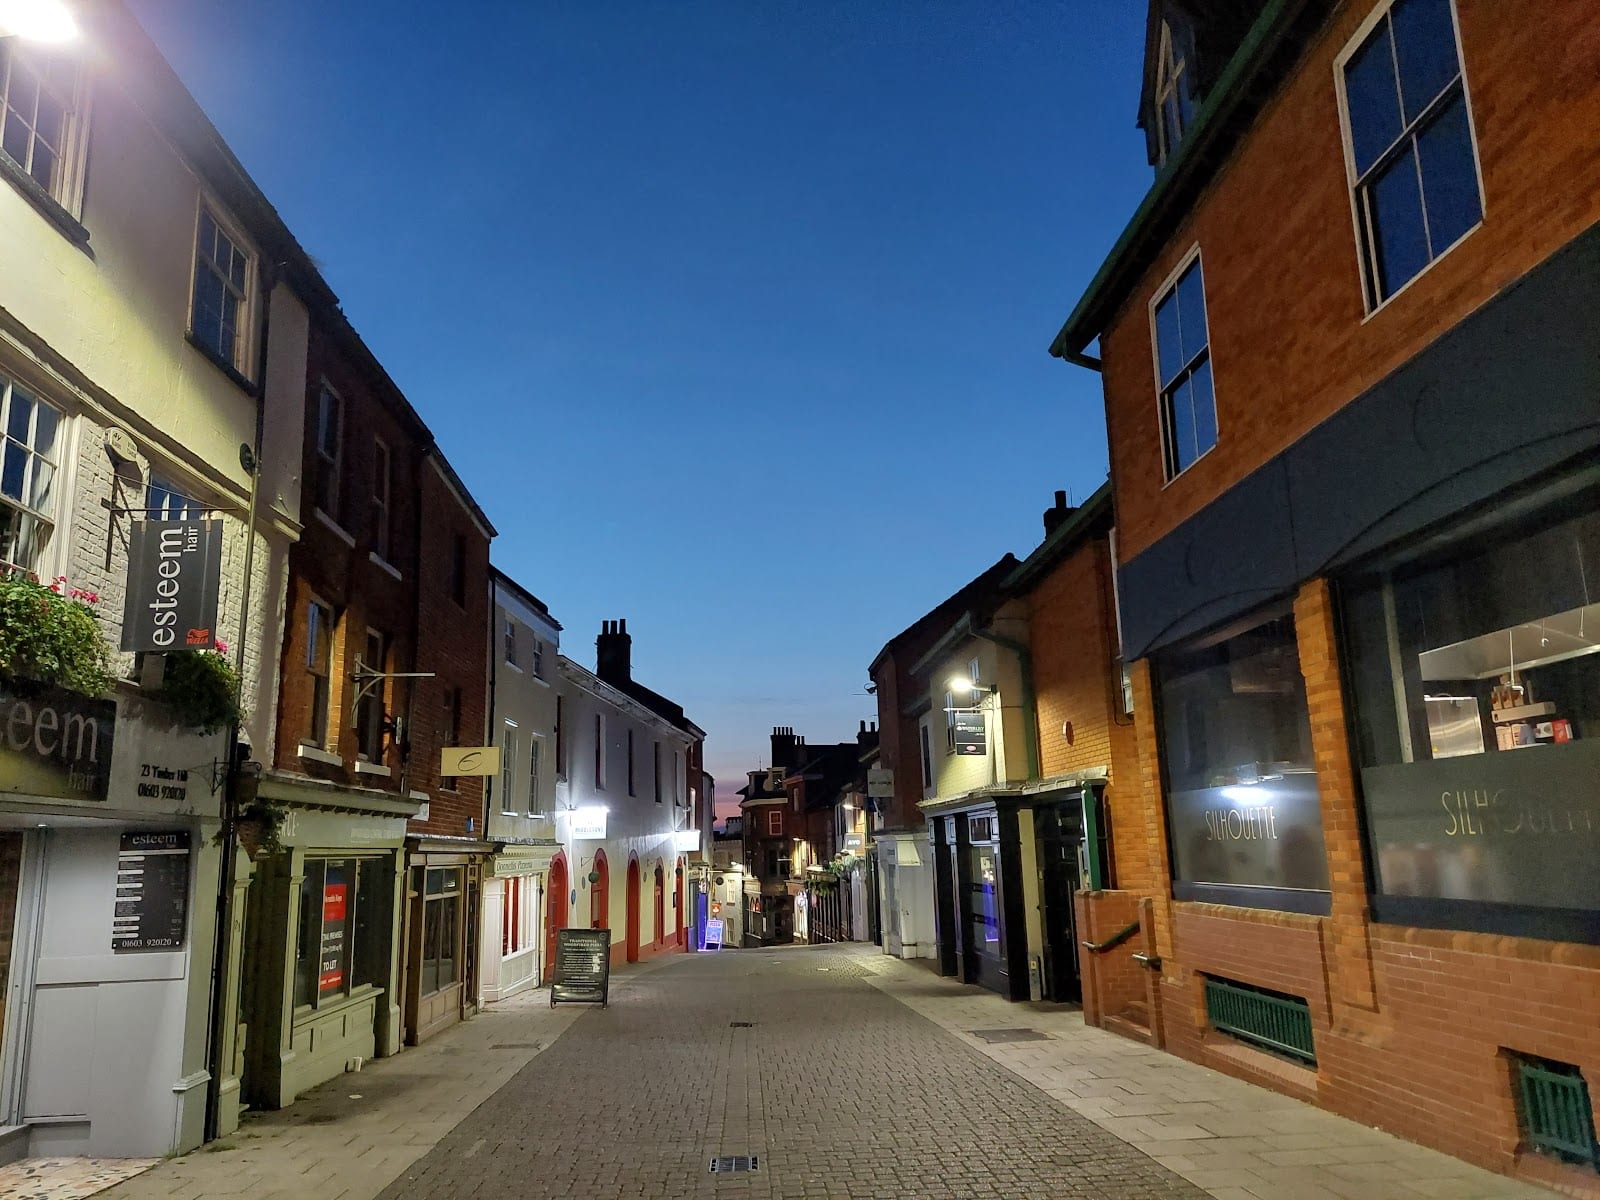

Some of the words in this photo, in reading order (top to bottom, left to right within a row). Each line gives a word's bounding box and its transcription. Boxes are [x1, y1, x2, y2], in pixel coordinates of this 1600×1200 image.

[183, 526, 198, 552] hair
[149, 526, 183, 646] esteem
[0, 701, 98, 763] eem
[141, 764, 150, 777] 23
[1205, 805, 1278, 840] SILHOUETTE
[132, 833, 177, 845] esteem
[121, 939, 143, 948] 01603
[146, 938, 172, 946] 920120
[323, 960, 330, 972] TO
[329, 959, 337, 970] LET
